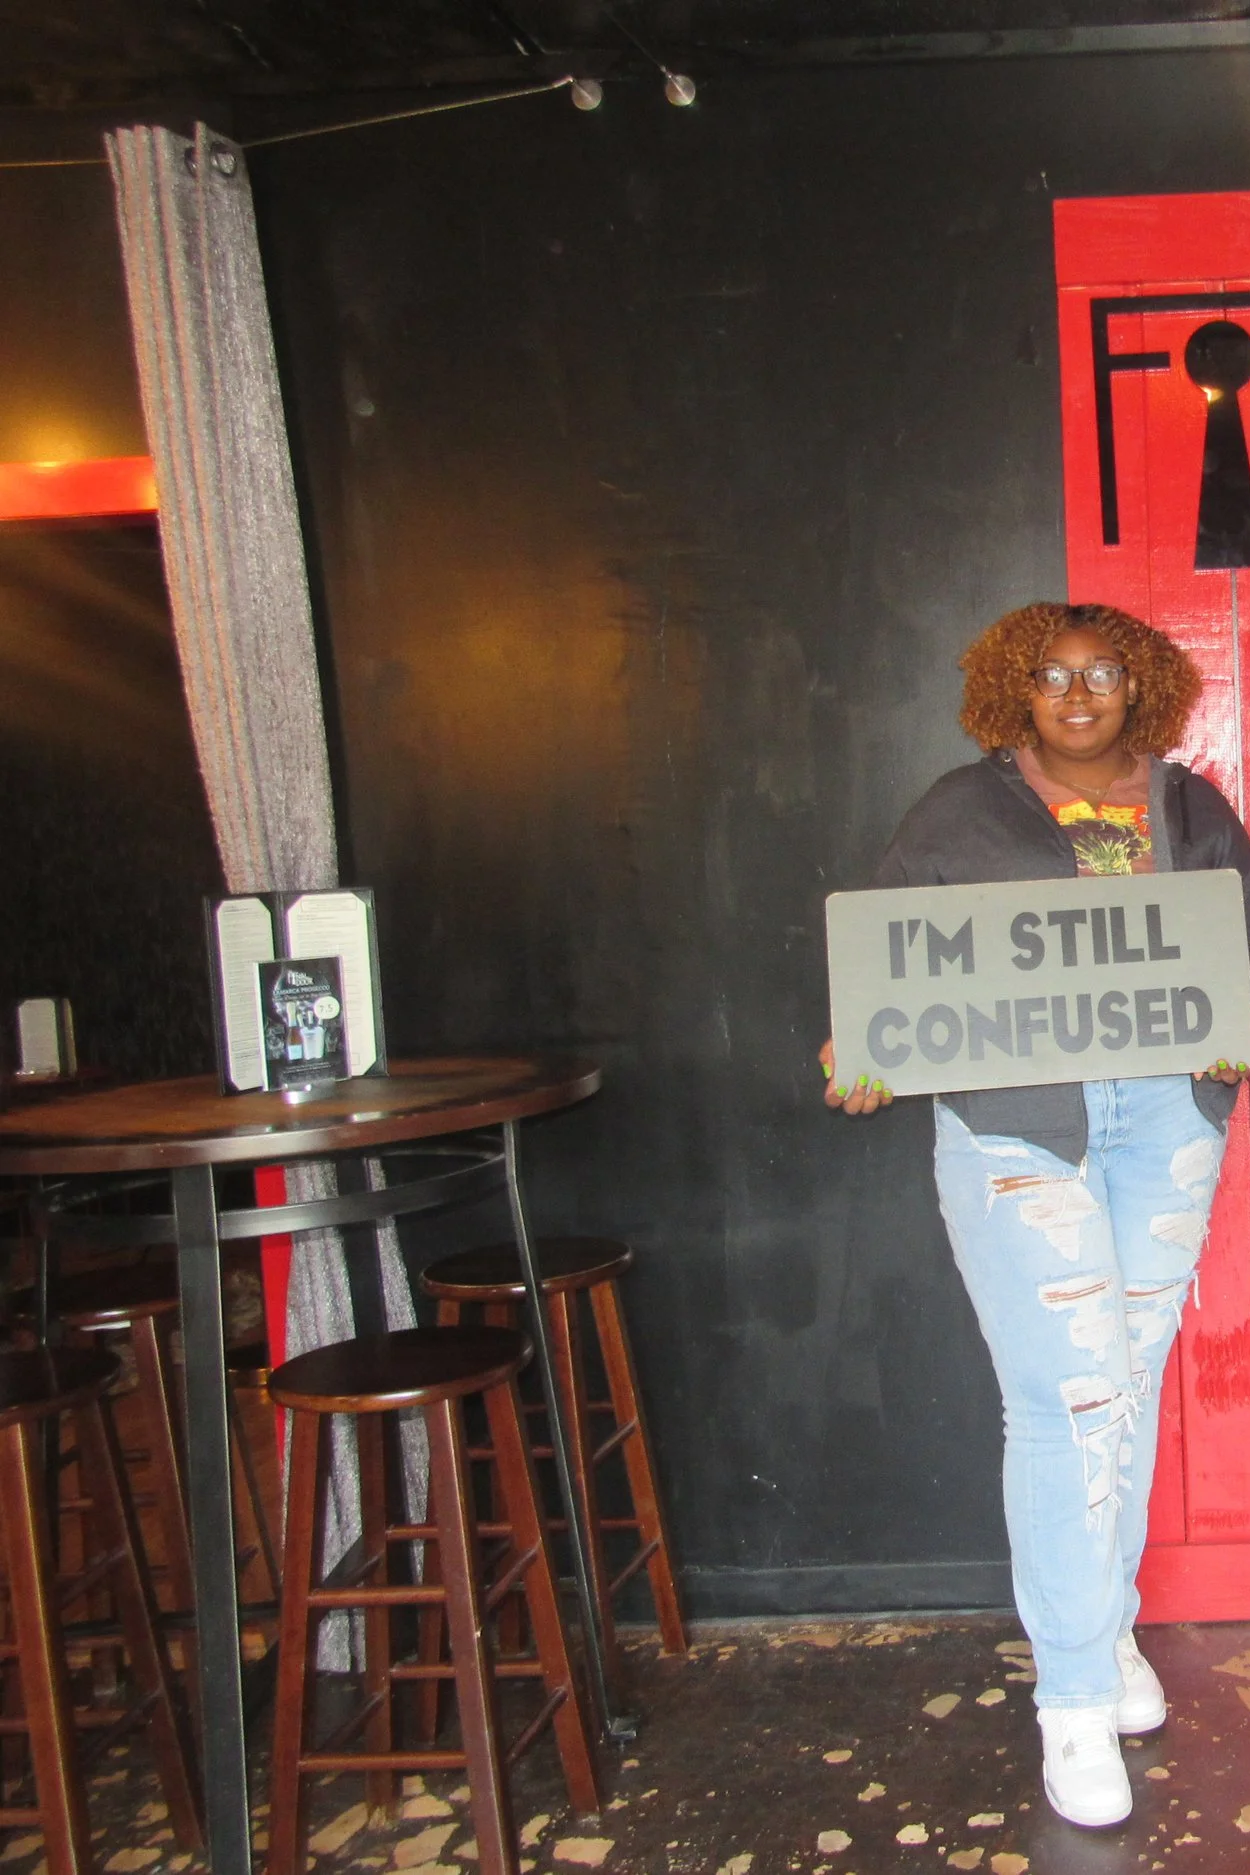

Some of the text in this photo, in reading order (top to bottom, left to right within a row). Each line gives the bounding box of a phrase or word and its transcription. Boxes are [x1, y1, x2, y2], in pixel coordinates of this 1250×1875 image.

[888, 904, 1181, 980] I'M STILL
[867, 986, 1213, 1069] CONFUSED
